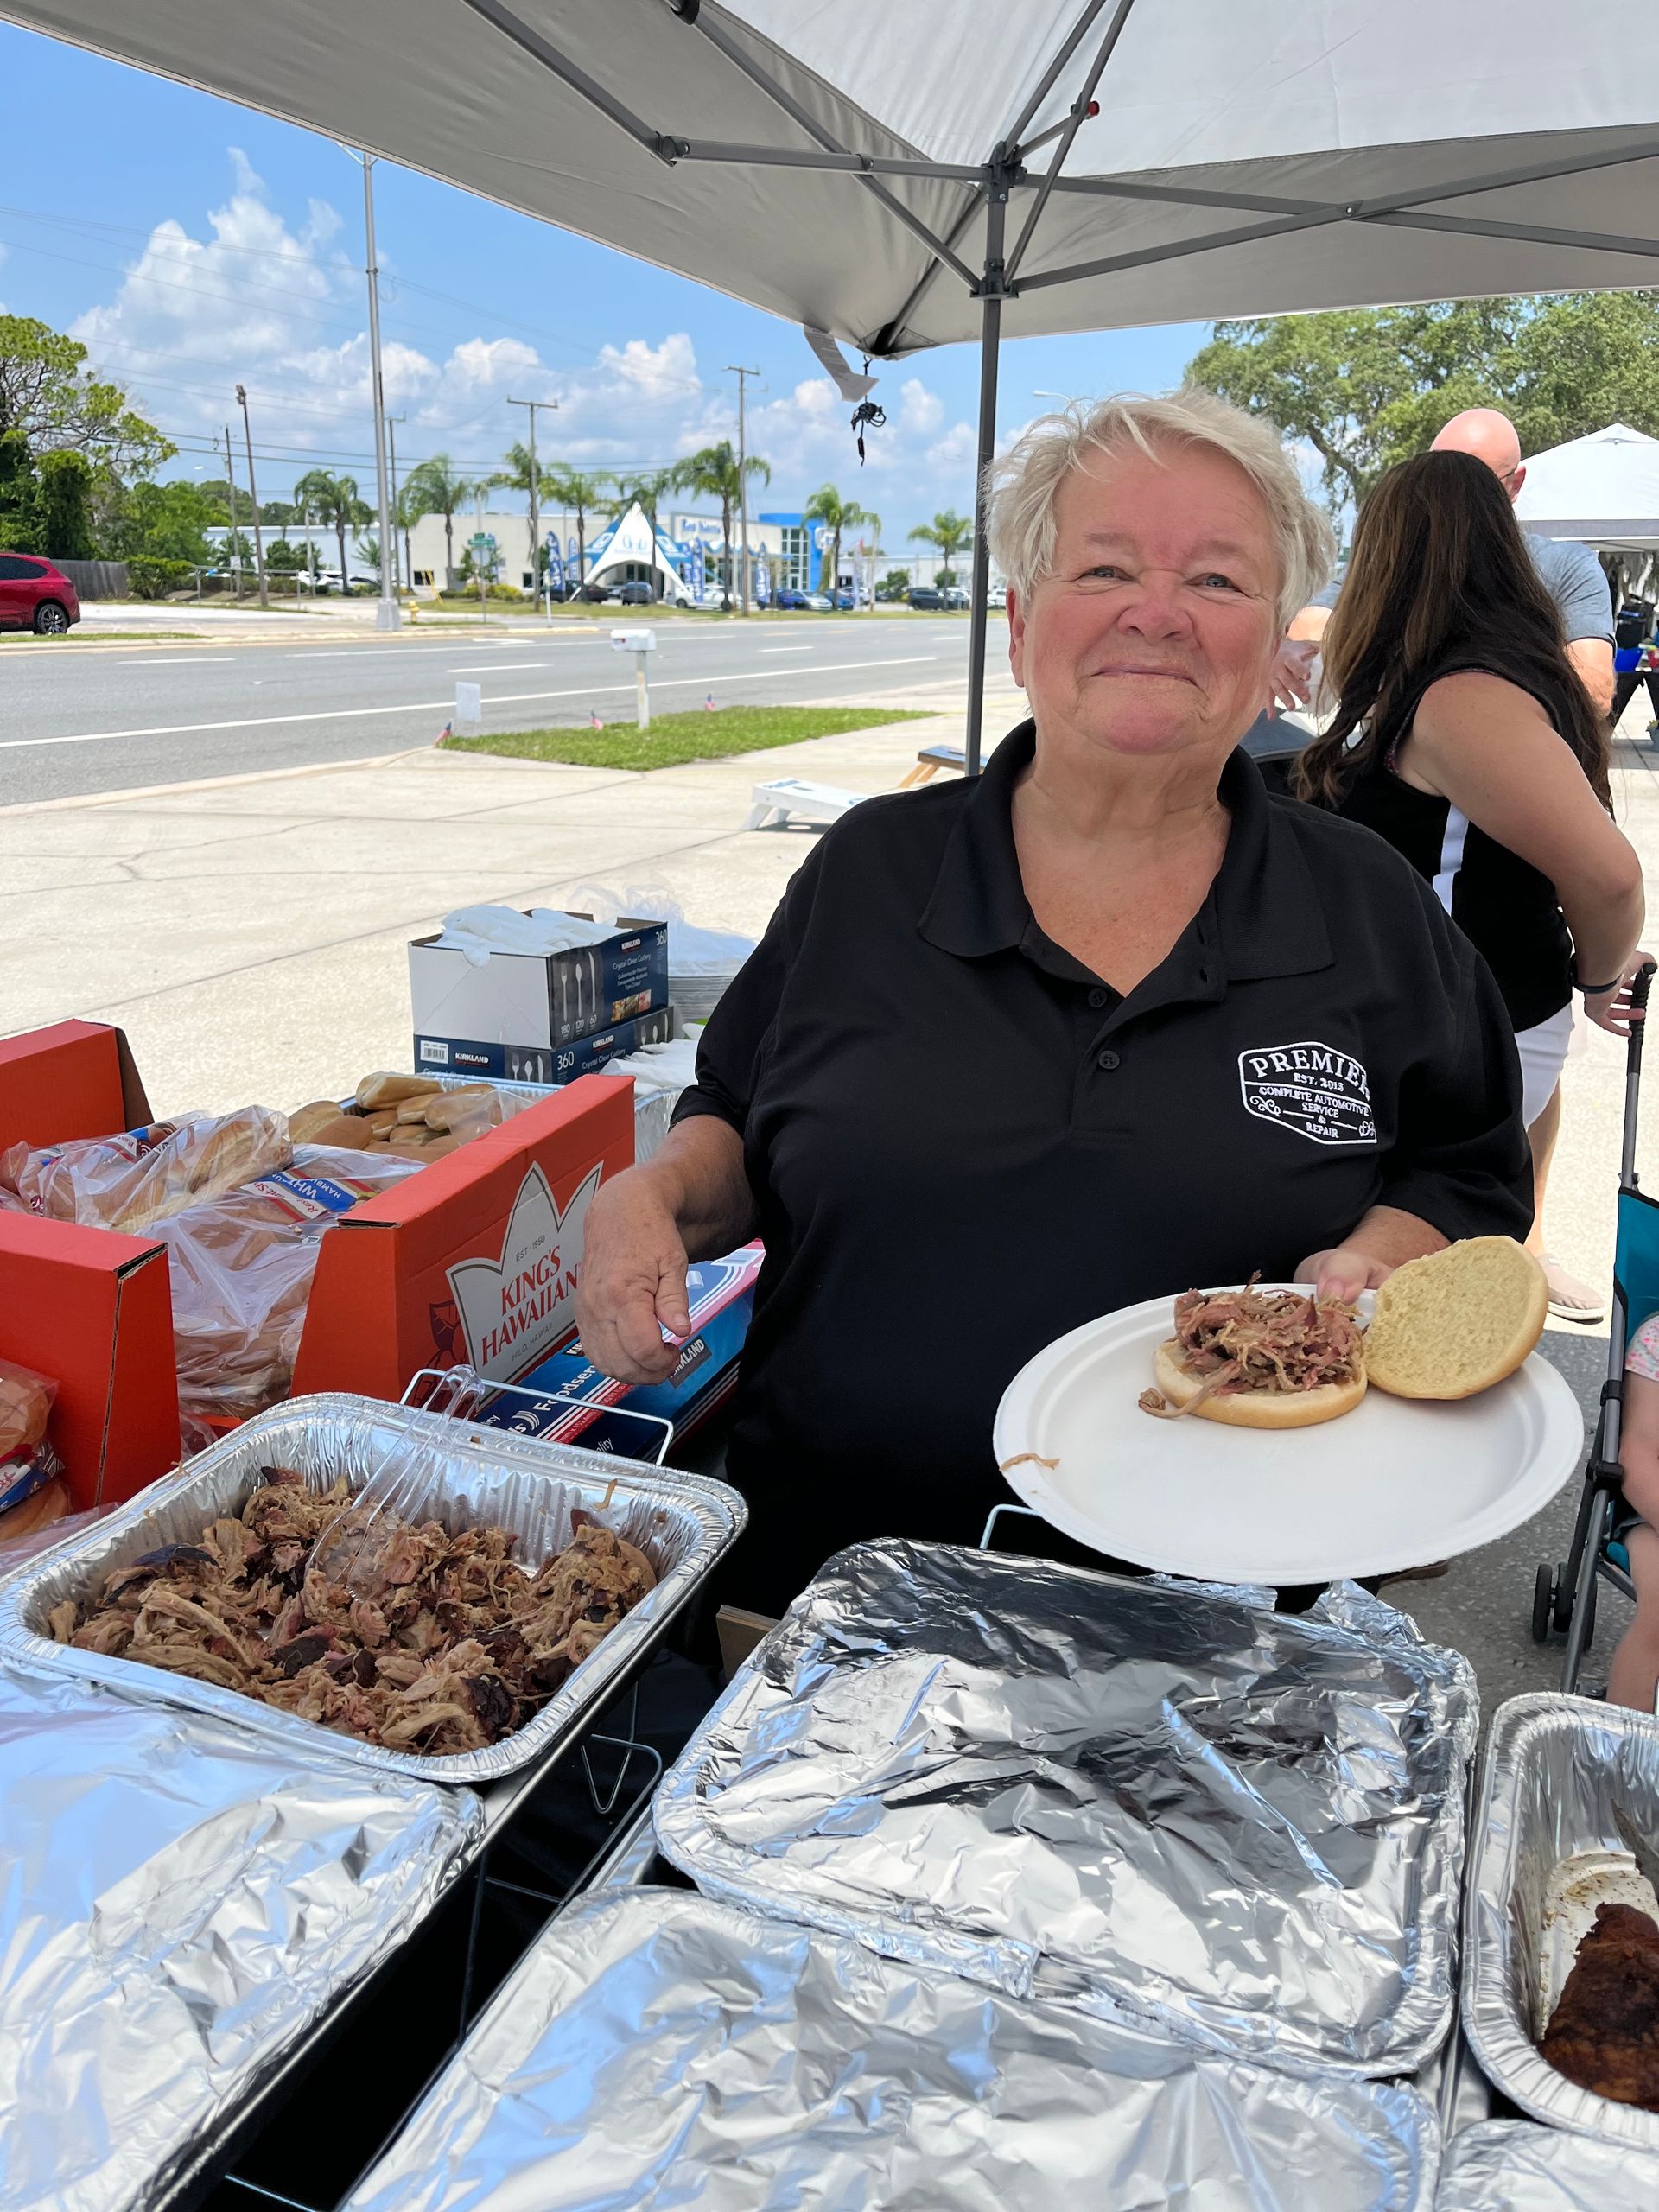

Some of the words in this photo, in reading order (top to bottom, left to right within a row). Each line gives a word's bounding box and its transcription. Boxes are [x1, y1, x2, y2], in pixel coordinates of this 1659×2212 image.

[656, 930, 668, 946] 360
[561, 1024, 570, 1034] 180
[575, 1020, 585, 1029] 120
[589, 1014, 597, 1024] 60
[454, 1052, 489, 1064] KIRKLAND
[557, 1051, 575, 1071] 360
[582, 1058, 598, 1070] Crystal
[598, 1053, 610, 1063] Clear
[1294, 1072, 1318, 1085] EST.
[1259, 1086, 1313, 1102] COMPLETE
[1314, 1094, 1370, 1116] AUTOMOTIVE
[1301, 1102, 1339, 1118] SERVICE
[1306, 1122, 1340, 1138] REPAIR
[516, 1247, 528, 1262] EST
[531, 1235, 546, 1249] 1950
[501, 1245, 561, 1316] KING'S
[482, 1263, 579, 1367] HAWAIIAN
